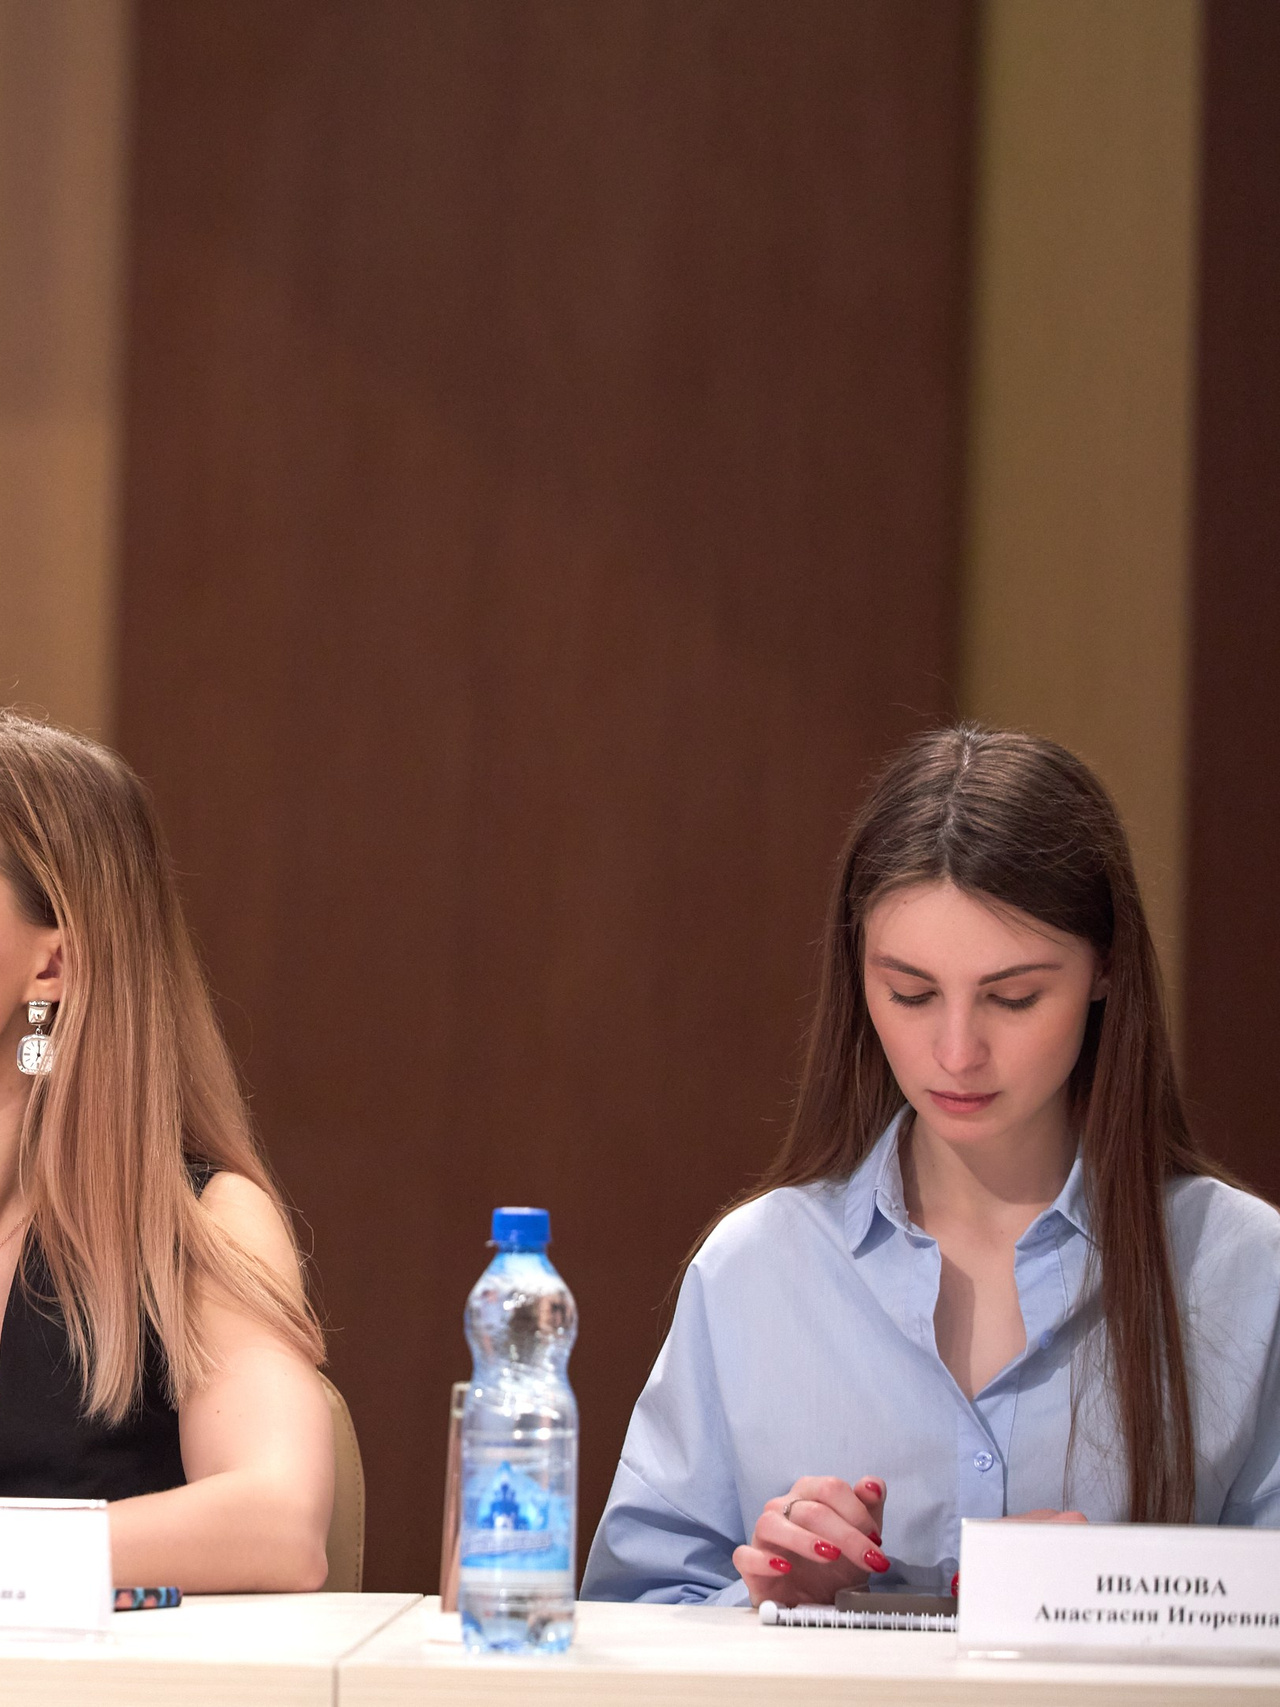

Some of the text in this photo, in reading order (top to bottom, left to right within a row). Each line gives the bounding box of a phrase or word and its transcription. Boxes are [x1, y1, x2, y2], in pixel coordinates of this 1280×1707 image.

[1096, 1575, 1227, 1596] ИВАНОВА
[1035, 1604, 1280, 1629] Анастасия Игоревна
